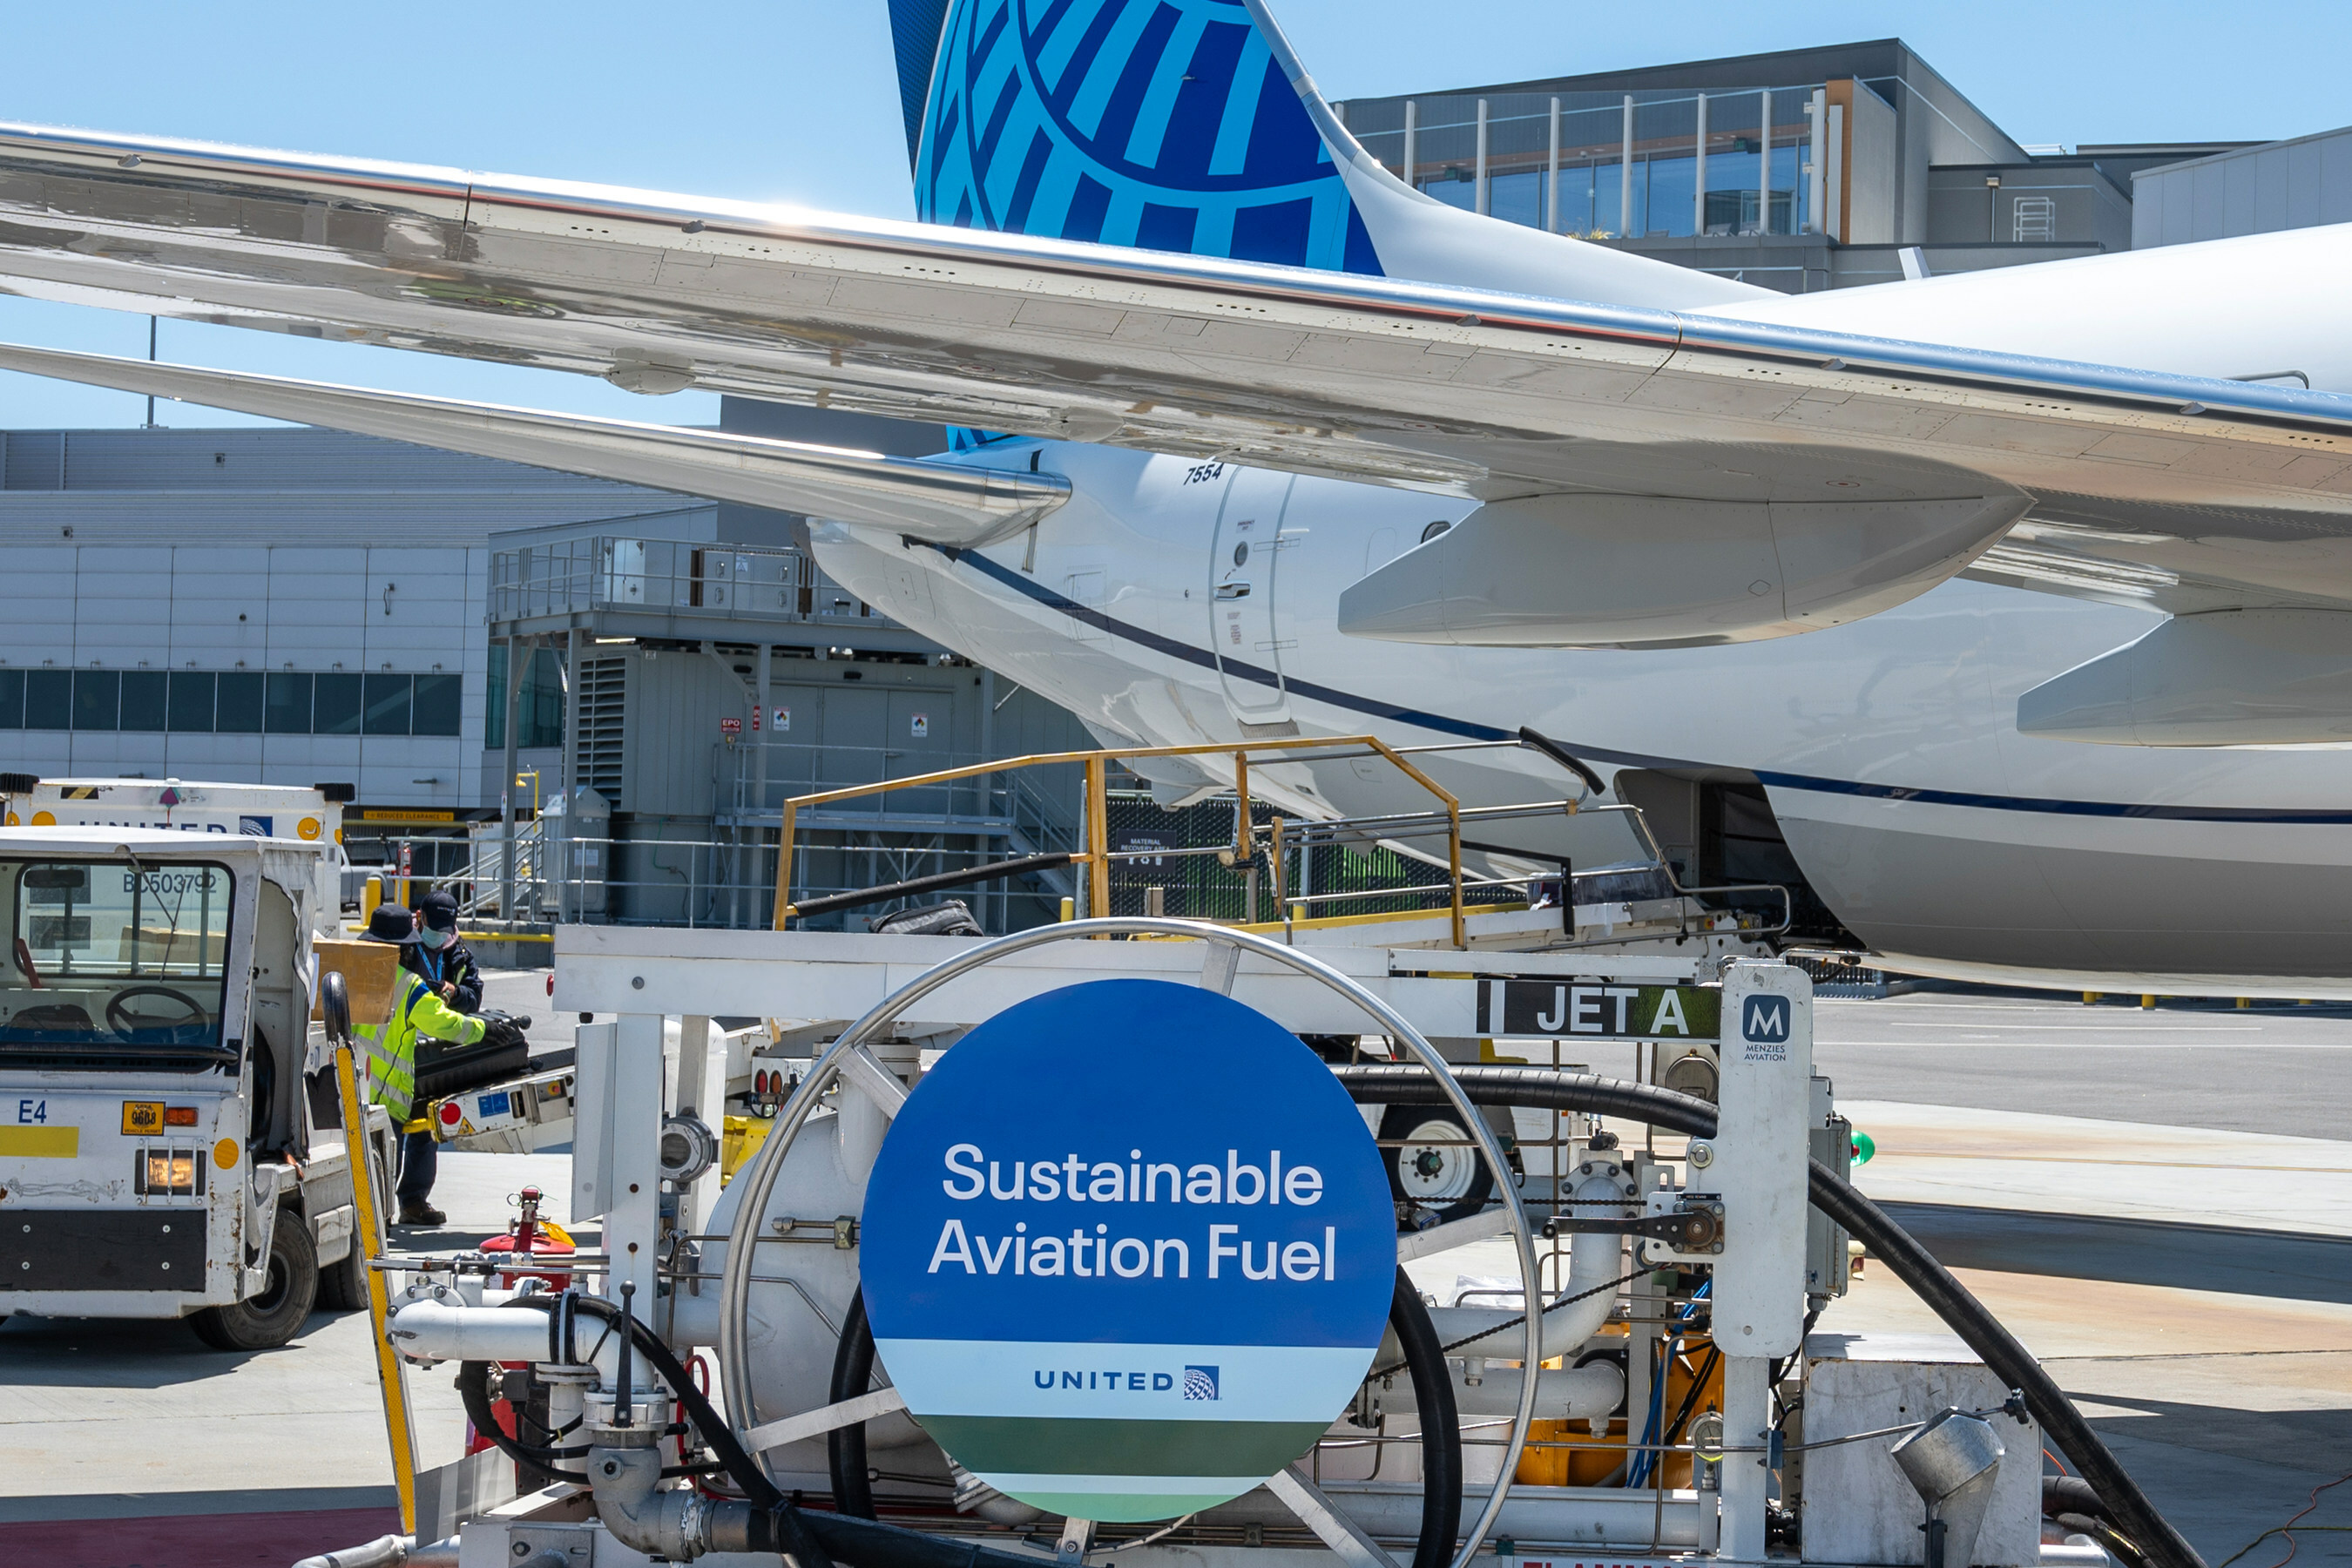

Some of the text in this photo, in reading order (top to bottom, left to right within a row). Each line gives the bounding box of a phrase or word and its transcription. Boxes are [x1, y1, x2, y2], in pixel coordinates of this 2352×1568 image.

[1183, 462, 1225, 485] 7554
[1537, 985, 1690, 1035] JET A
[1748, 1003, 1784, 1036] M
[1744, 1053, 1787, 1062] AVIATION
[1746, 1044, 1786, 1053] MENZIES
[17, 1099, 47, 1124] E4
[942, 1143, 1323, 1206] Sustainable
[927, 1219, 1335, 1281] Aviation Fuel
[1034, 1370, 1174, 1391] UNITED
